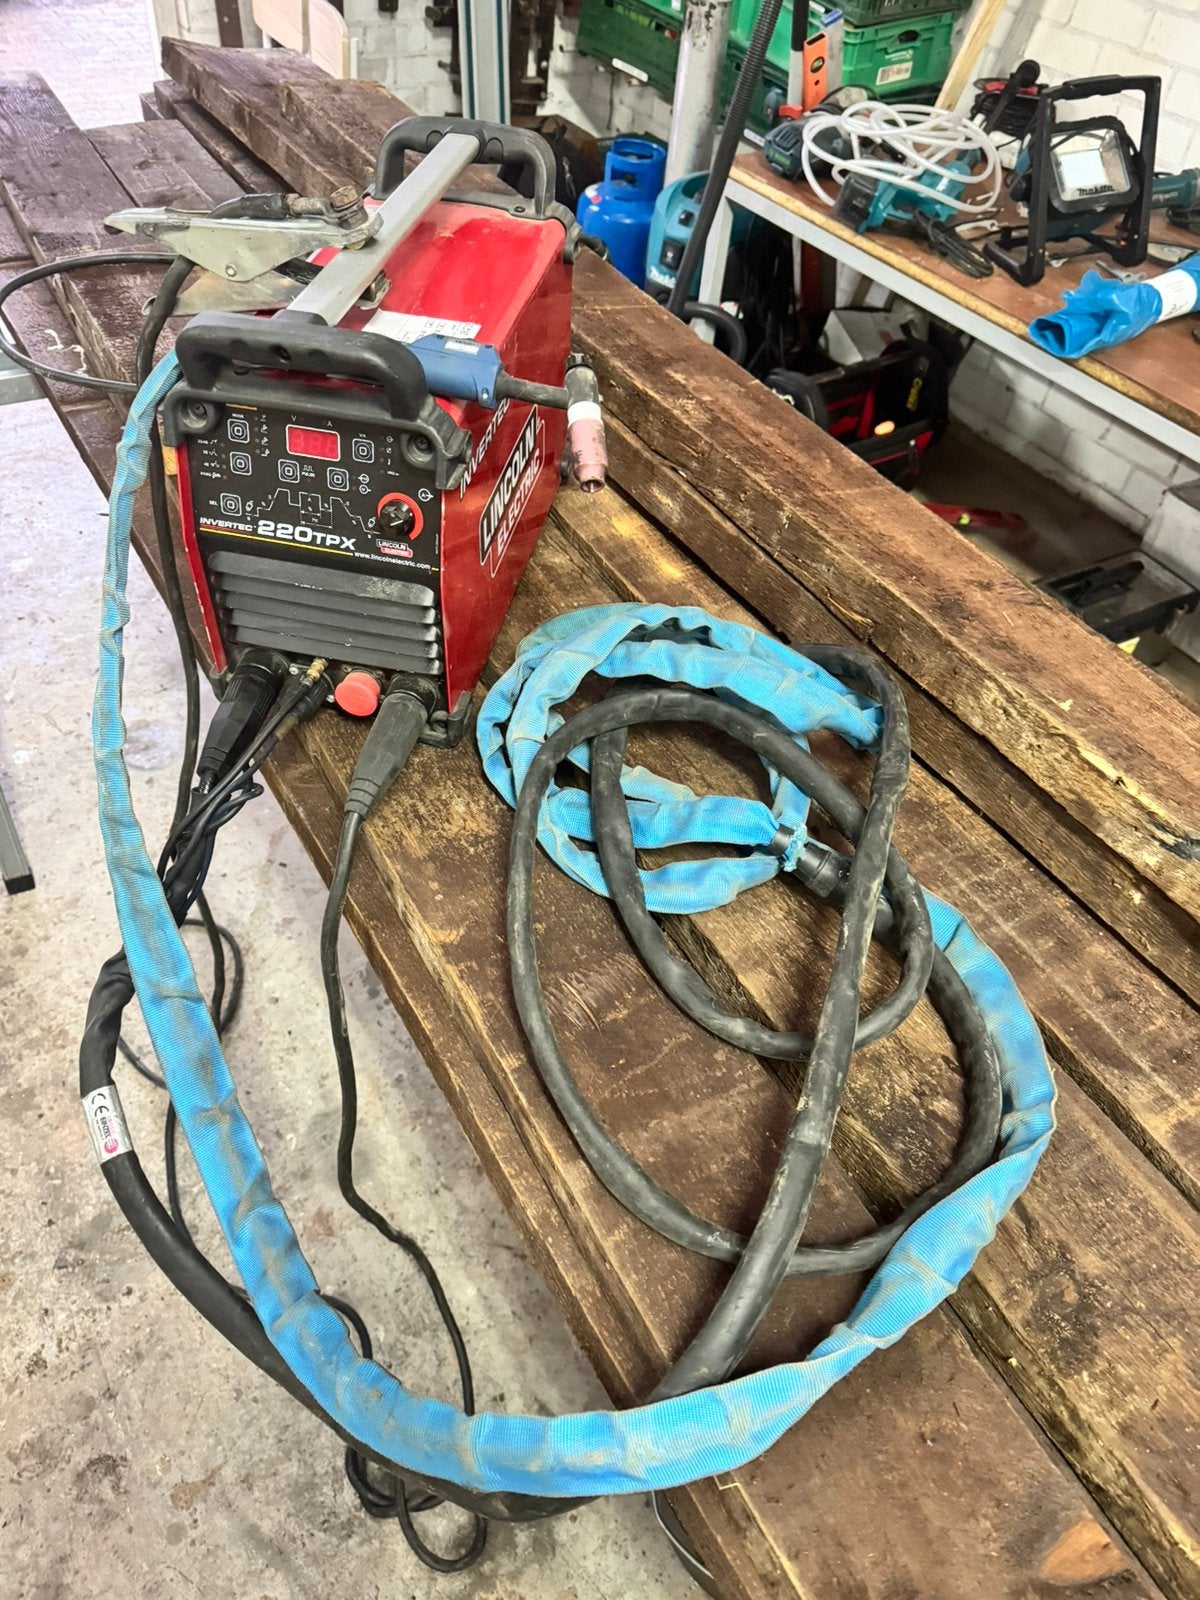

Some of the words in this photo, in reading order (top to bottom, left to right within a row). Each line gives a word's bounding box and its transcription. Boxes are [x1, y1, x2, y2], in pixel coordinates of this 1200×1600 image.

[327, 420, 333, 428] A
[482, 417, 536, 550] LINCOLN
[496, 447, 541, 557] ELECTRIC
[199, 517, 253, 532] INVERTEC
[256, 519, 357, 551] 220TPX
[377, 541, 407, 551] LINCOLN
[354, 551, 431, 570] www.lincolnelectric.com
